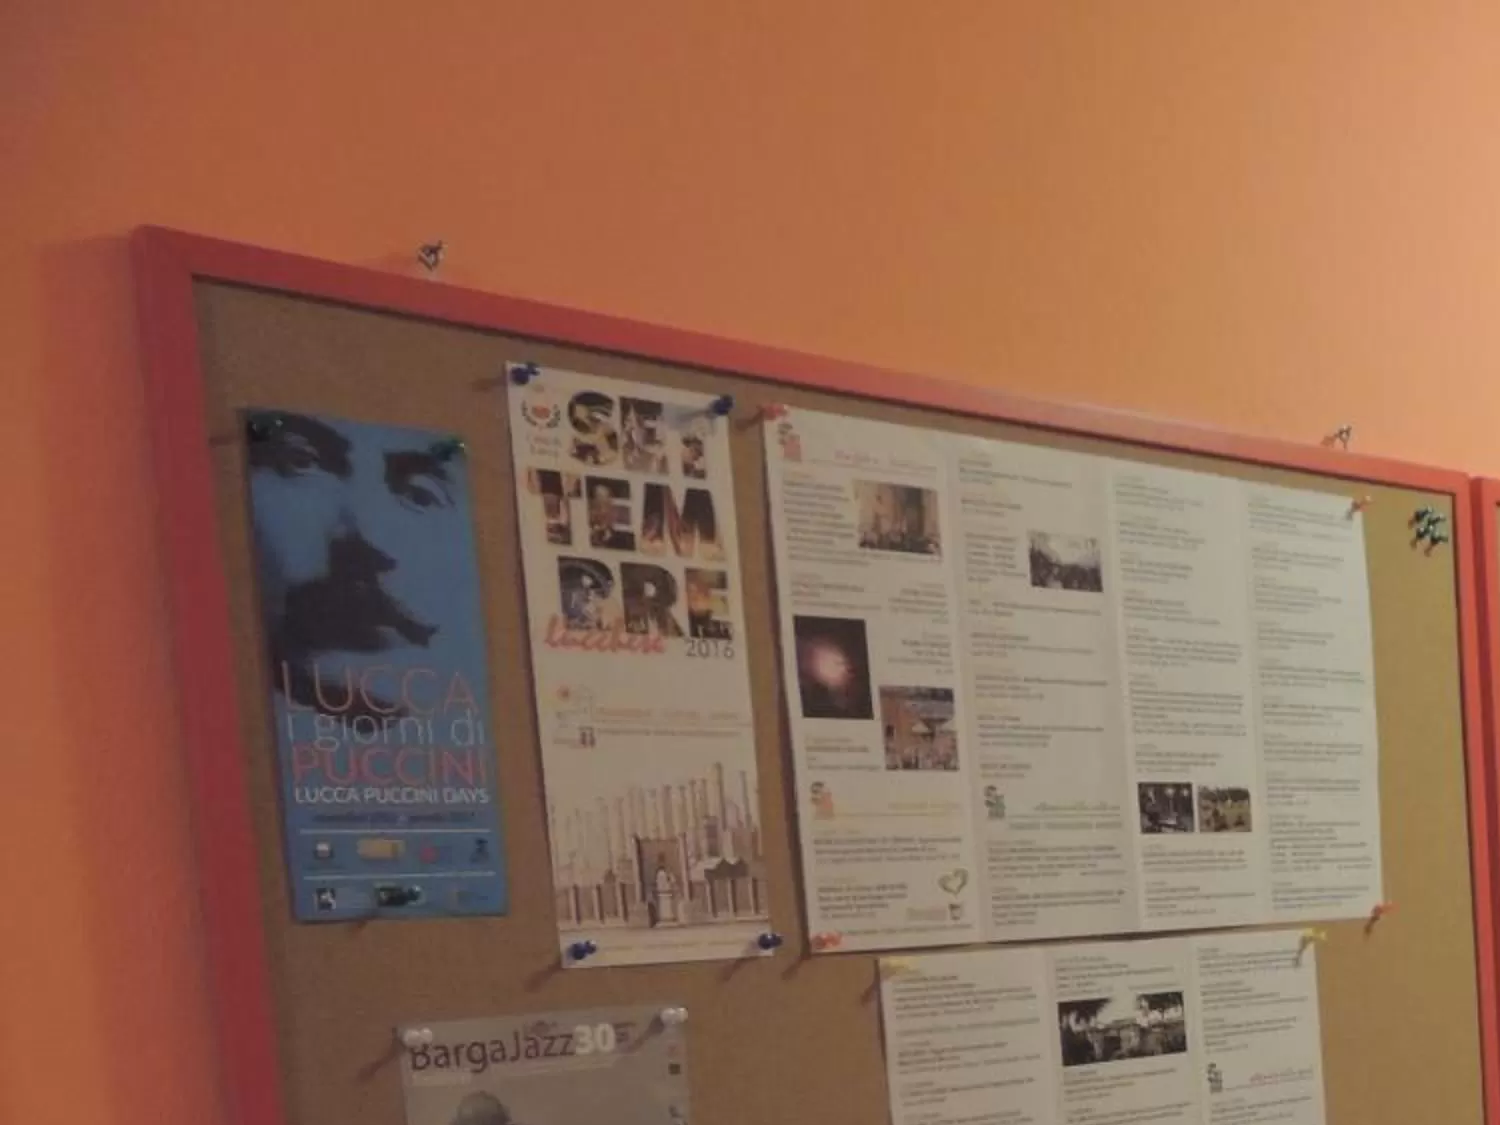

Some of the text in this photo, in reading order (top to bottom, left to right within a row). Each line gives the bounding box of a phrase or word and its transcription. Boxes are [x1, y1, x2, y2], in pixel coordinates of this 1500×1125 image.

[684, 637, 735, 660] 2016
[281, 660, 480, 715] LUCCA
[313, 711, 435, 753] giorni
[450, 708, 486, 747] di
[292, 743, 487, 788] PUCCINI
[295, 786, 490, 805] LUCCA PUCCINI DAYS
